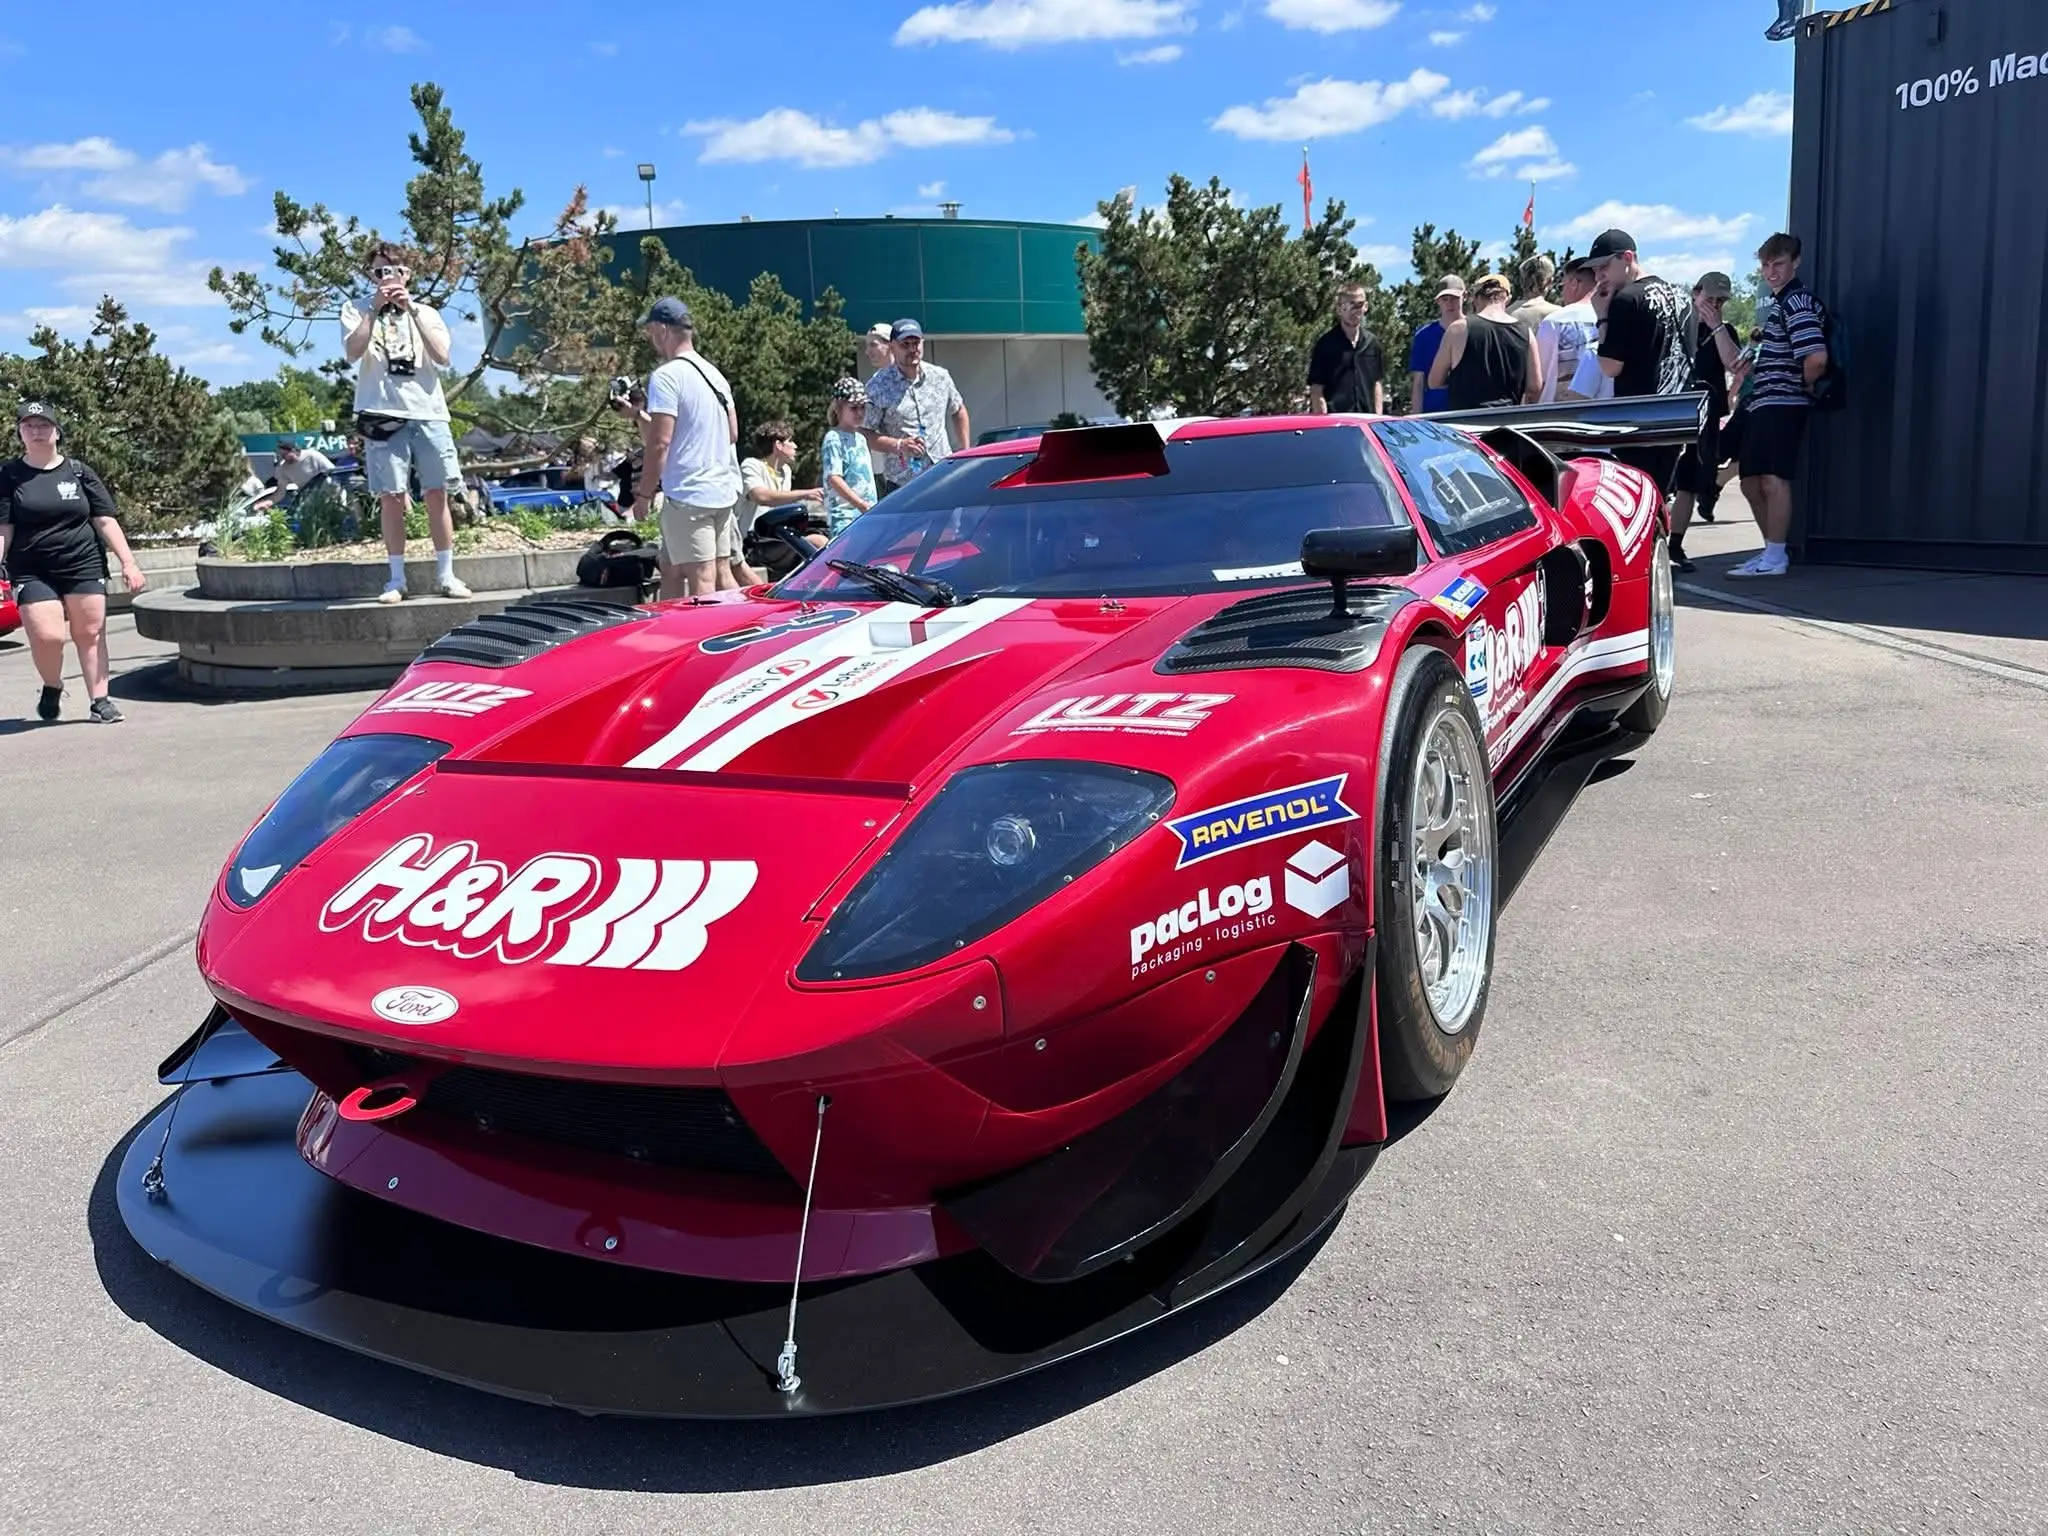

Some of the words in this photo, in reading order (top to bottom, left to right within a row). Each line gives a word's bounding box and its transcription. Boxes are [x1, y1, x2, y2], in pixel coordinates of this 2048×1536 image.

[1895, 66, 1979, 110] 100%
[822, 660, 876, 689] Lohse
[376, 681, 535, 713] LUTZ
[1015, 693, 1236, 731] LUTZ
[1191, 796, 1329, 848] RAVENOL
[319, 832, 602, 965] H&R
[1130, 875, 1273, 965] pacLog
[1131, 937, 1203, 980] packaging
[1216, 914, 1276, 940] logistic
[386, 990, 443, 1017] Ford
